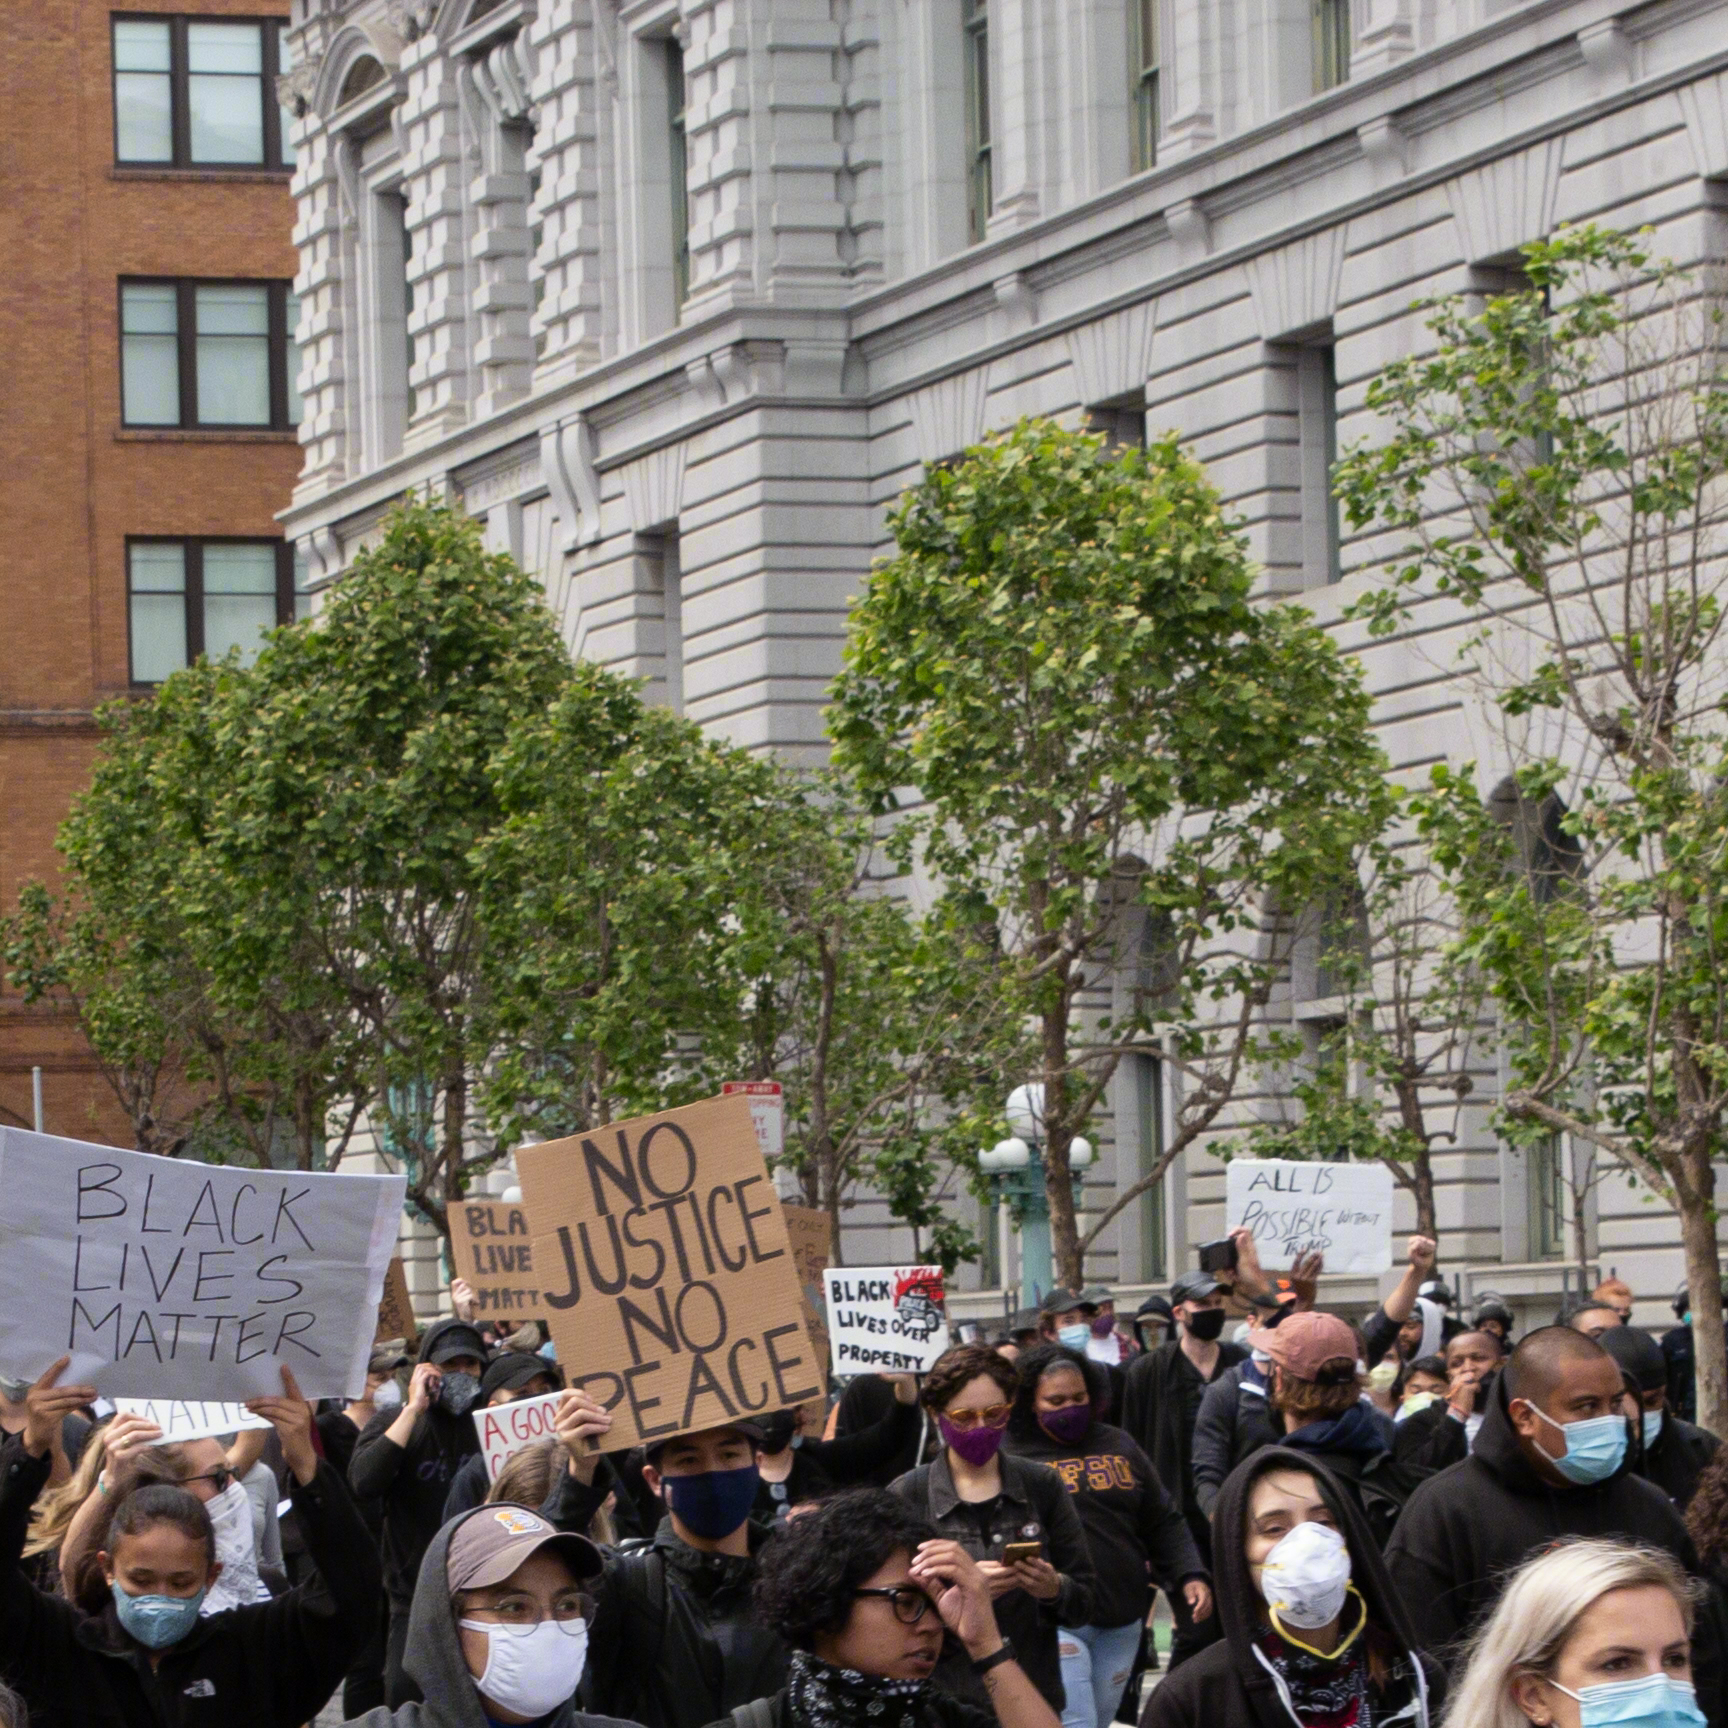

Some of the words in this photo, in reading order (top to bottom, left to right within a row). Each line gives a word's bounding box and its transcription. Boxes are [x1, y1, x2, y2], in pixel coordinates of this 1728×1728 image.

[580, 1121, 697, 1216] NO
[1248, 1168, 1302, 1192] ALL
[1313, 1166, 1335, 1195] IS
[76, 1162, 316, 1252] BLACK
[465, 1206, 528, 1237] BLA
[1240, 1200, 1335, 1242] POSSIBLE
[472, 1243, 533, 1274] LIVE
[543, 1174, 786, 1310] JUSTICE
[73, 1235, 304, 1304] LIVES
[477, 1287, 540, 1310] MATT
[831, 1279, 890, 1303] BLACK
[68, 1296, 322, 1365] MATTER
[617, 1279, 728, 1365] NO
[836, 1310, 888, 1335] LIVES
[891, 1319, 931, 1344] OVER
[838, 1343, 925, 1371] PROPERTY
[572, 1322, 821, 1452] PEACE
[130, 1400, 260, 1435] MATTE
[484, 1413, 509, 1450] A
[511, 1402, 564, 1441] GOO
[1045, 1455, 1134, 1494] FSU
